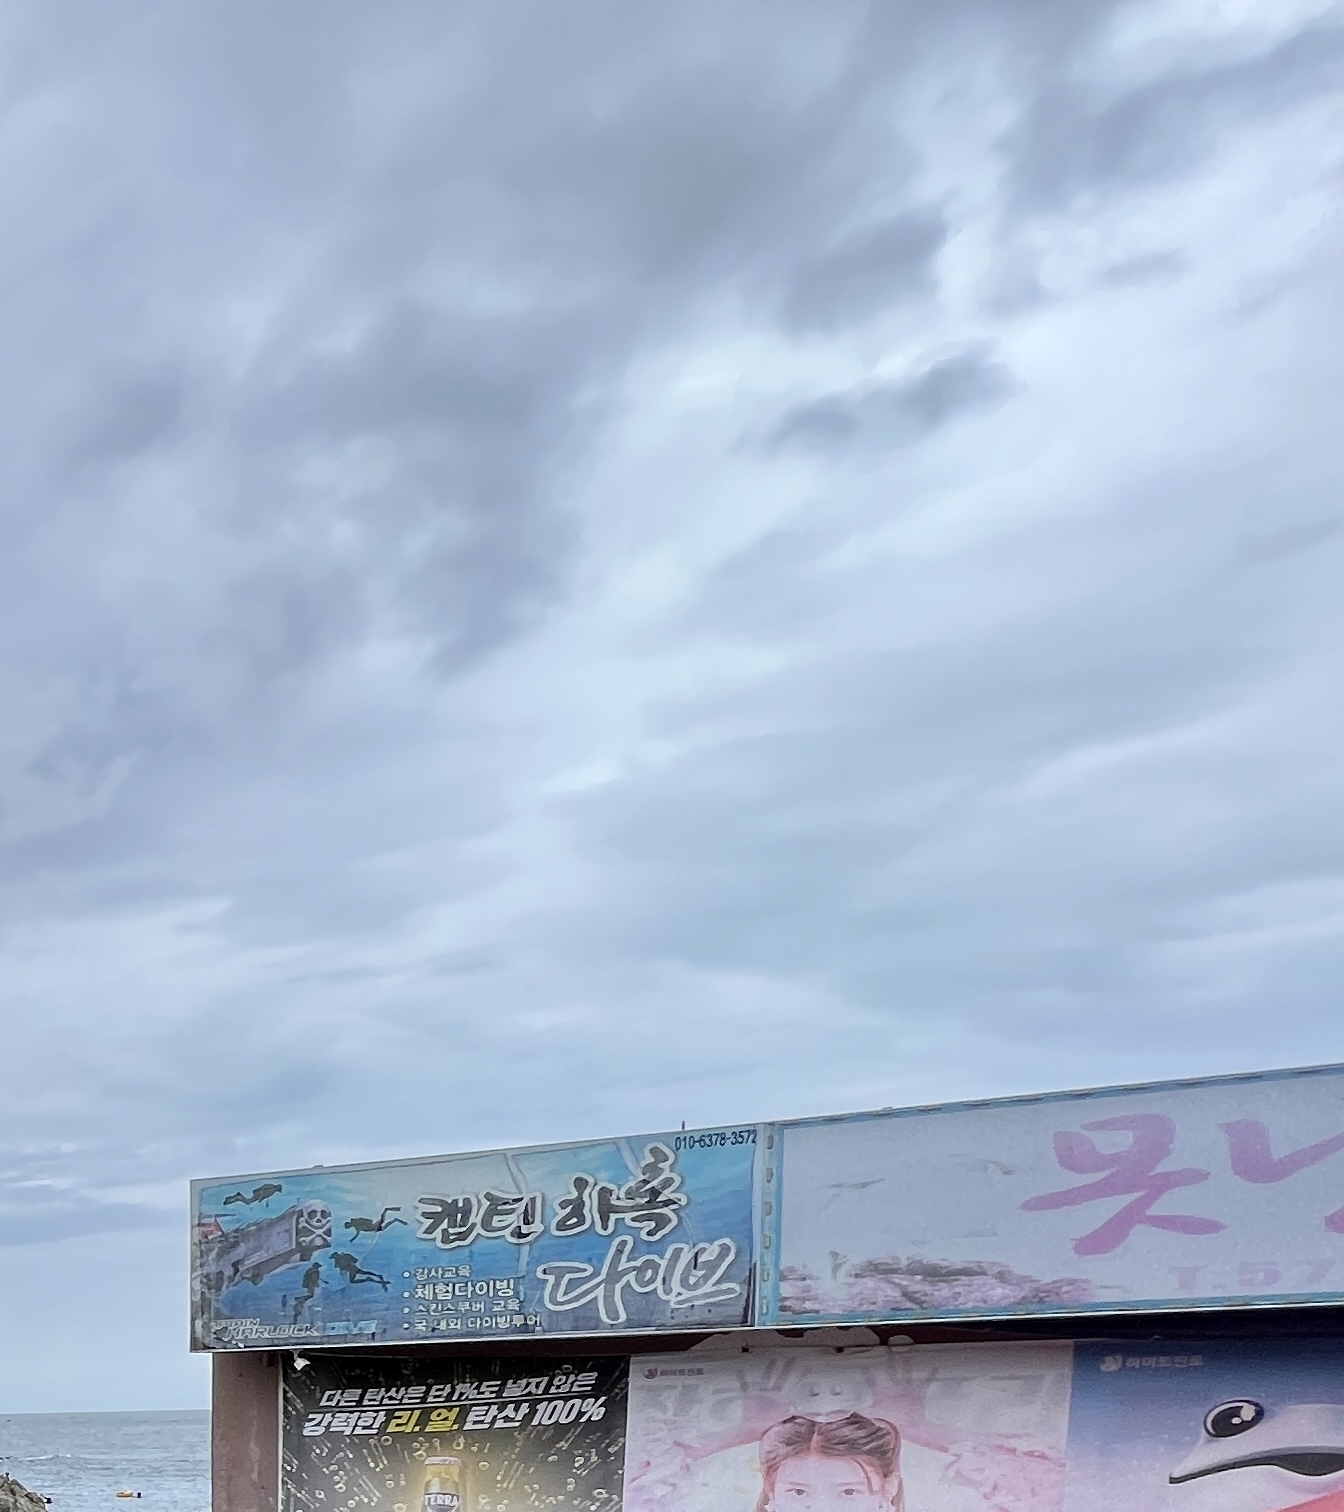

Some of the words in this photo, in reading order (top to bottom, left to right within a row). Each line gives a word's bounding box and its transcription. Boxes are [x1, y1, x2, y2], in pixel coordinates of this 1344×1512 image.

[675, 1129, 757, 1152] 010-6378-3572
[415, 1190, 544, 1249] 캡틴
[551, 1142, 688, 1242] 하록
[414, 1278, 515, 1301] 체험다이빙
[415, 1301, 485, 1316] 스킨스쿠버
[491, 1298, 521, 1312] 교육
[467, 1312, 541, 1330] 다이빙투어
[319, 1388, 363, 1407] 다른
[362, 1385, 427, 1406] 탄산은
[426, 1383, 452, 1403] 단
[548, 1371, 599, 1394] 않은
[301, 1411, 387, 1437] 강력한
[530, 1395, 609, 1427] 100%
[424, 1493, 460, 1507] TERRA
